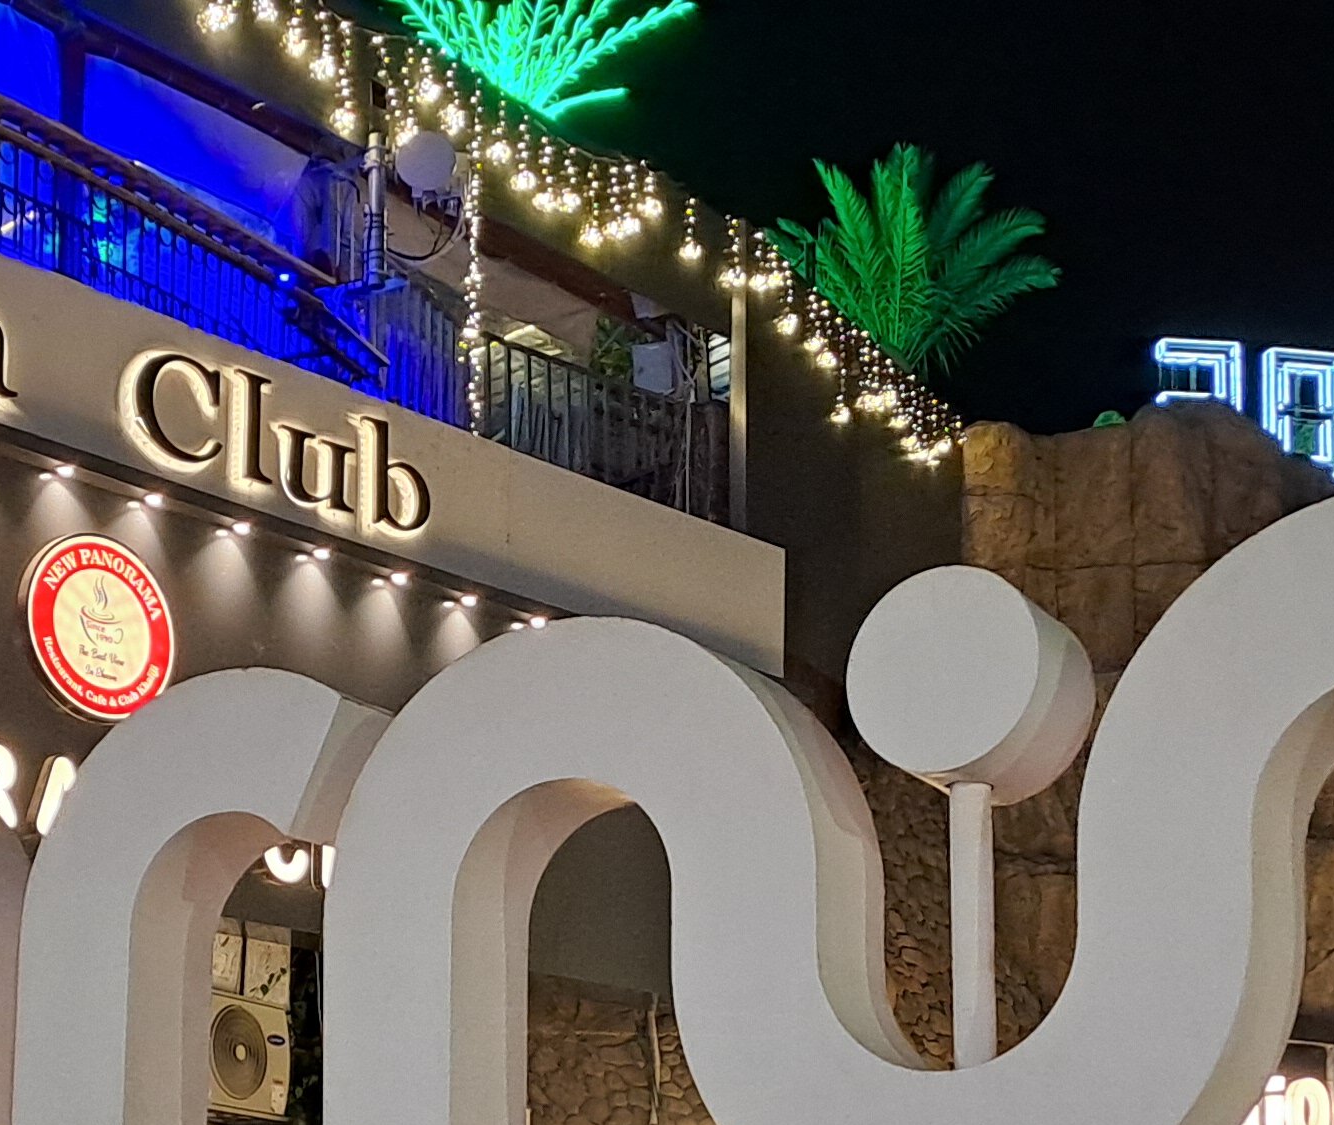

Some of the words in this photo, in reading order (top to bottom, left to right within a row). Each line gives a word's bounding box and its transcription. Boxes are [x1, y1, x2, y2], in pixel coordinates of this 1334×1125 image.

[131, 350, 433, 534] Club
[43, 551, 77, 590] NEW
[78, 548, 162, 621] PANORAMA
